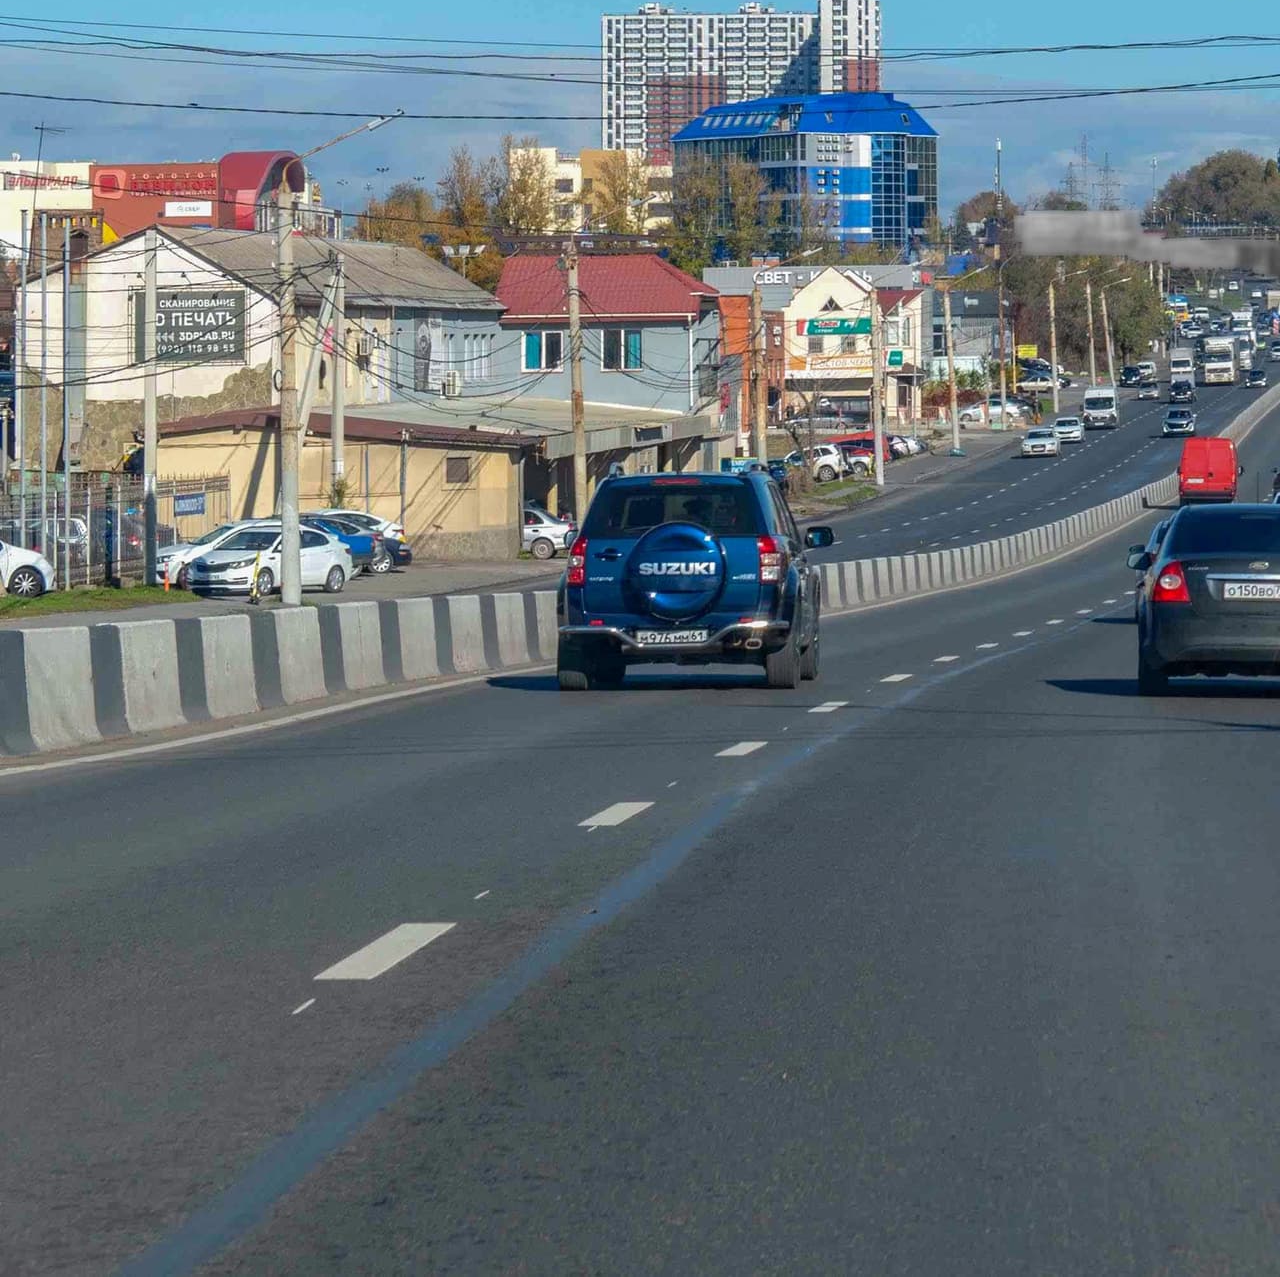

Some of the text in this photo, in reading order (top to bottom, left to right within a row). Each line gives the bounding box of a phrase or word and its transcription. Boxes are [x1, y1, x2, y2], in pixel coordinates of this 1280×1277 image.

[131, 170, 217, 180] ЗОЛОТОЙ
[753, 271, 792, 284] СВЕТ
[159, 299, 236, 308] СКАНИРОВАНИЕ
[171, 311, 236, 327] ПЕЧАТЬ
[639, 562, 716, 575] SUZUKI
